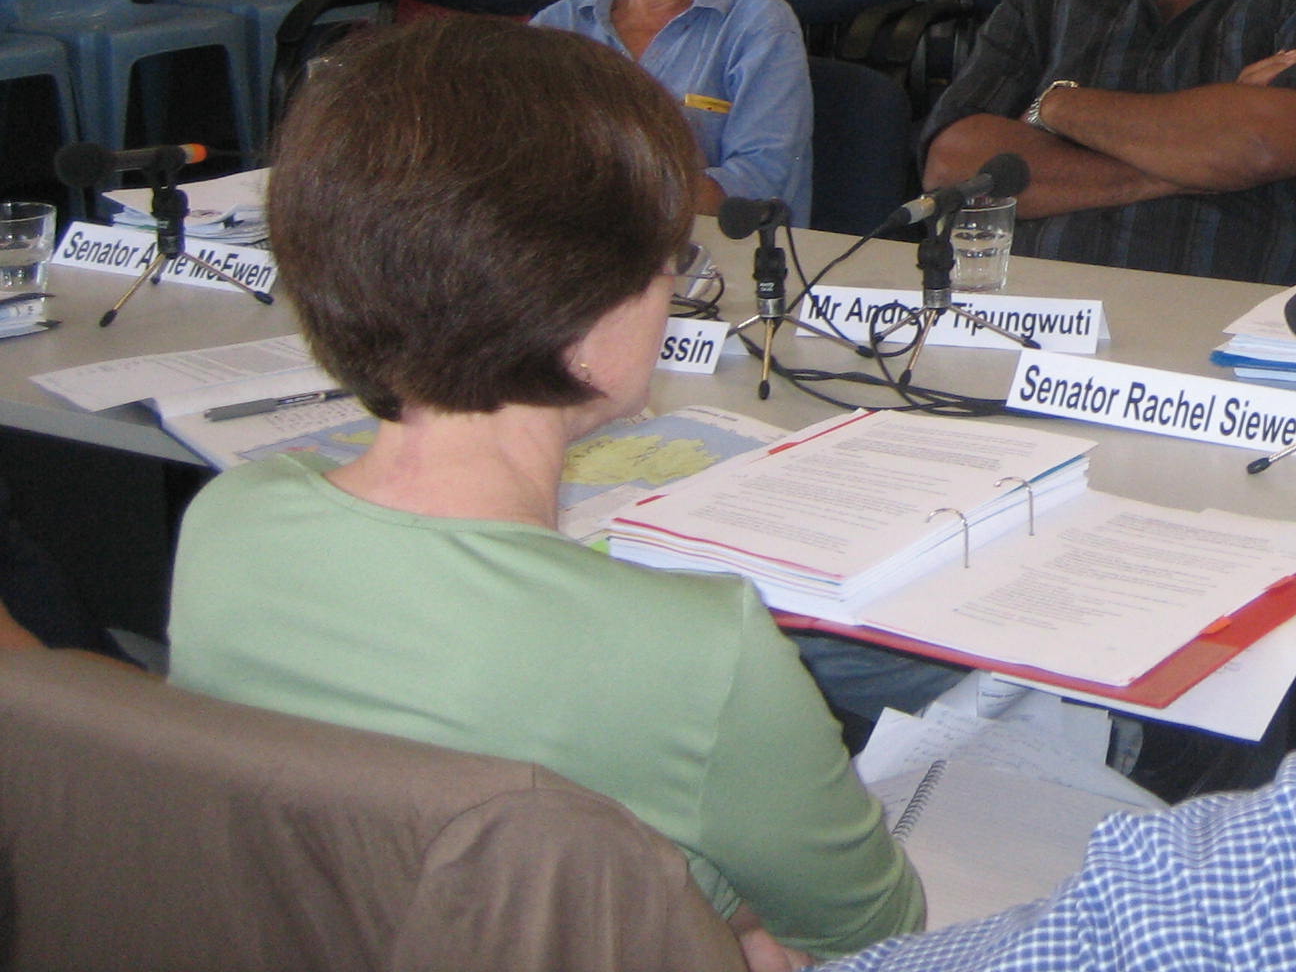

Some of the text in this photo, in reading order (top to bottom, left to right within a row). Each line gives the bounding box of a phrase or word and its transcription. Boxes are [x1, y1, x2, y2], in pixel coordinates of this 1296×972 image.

[62, 231, 272, 288] Senator Ae McEwen
[808, 294, 841, 321] Mr
[951, 301, 1092, 340] Tipungwuti
[1020, 364, 1120, 415] Senator
[1123, 381, 1217, 432] Rachel
